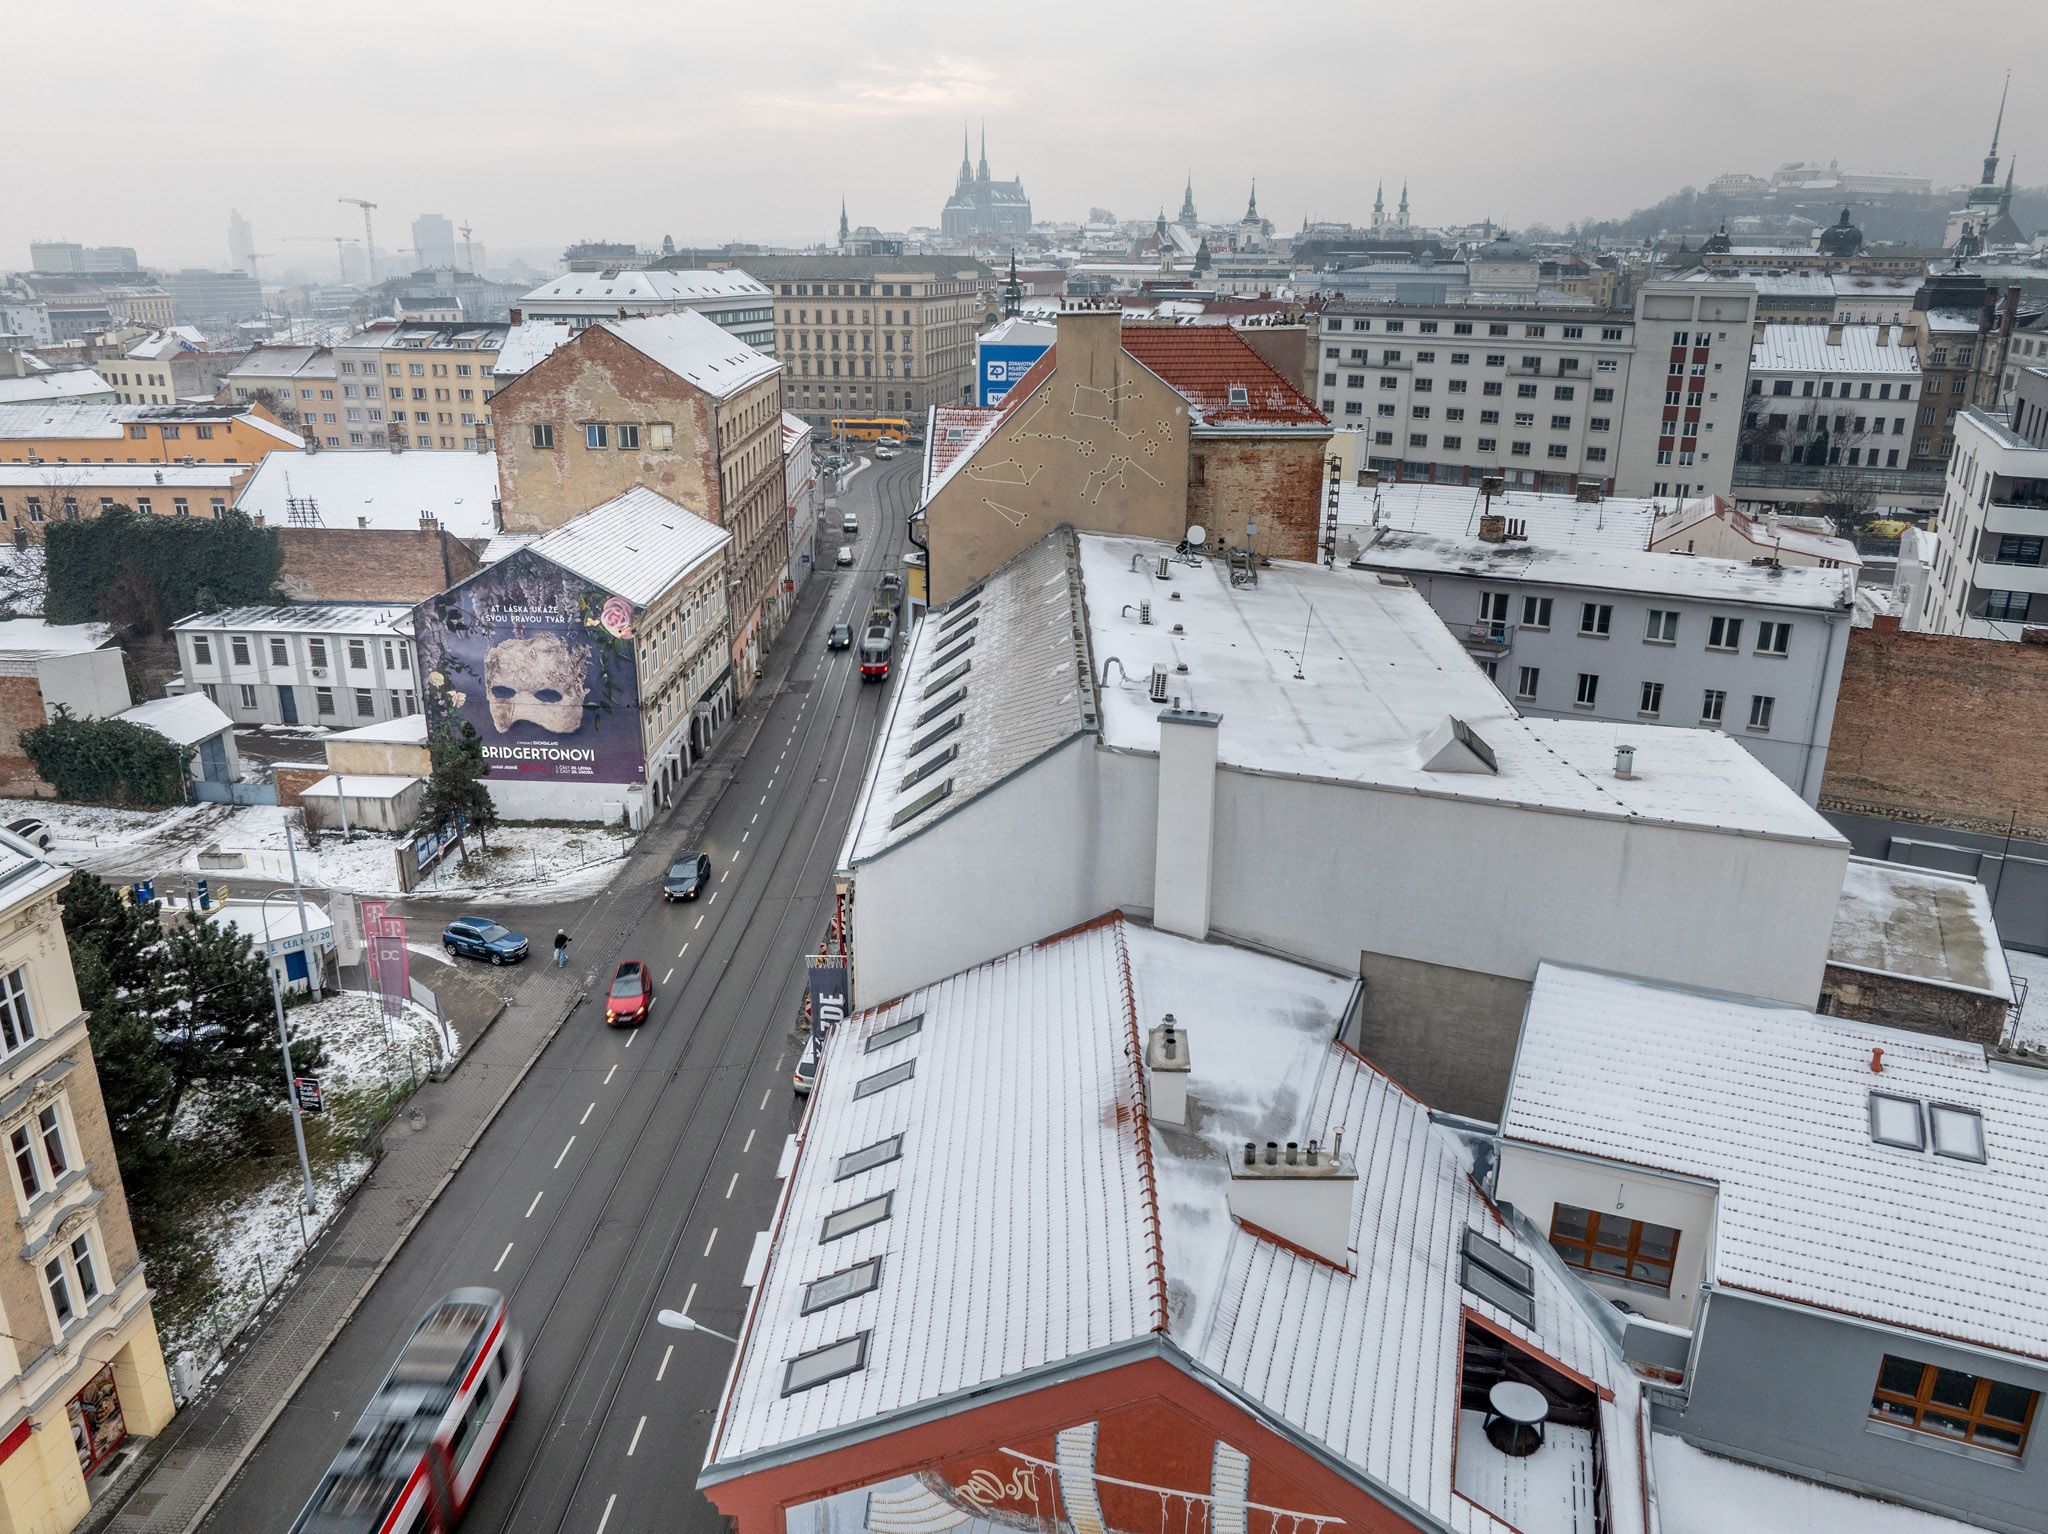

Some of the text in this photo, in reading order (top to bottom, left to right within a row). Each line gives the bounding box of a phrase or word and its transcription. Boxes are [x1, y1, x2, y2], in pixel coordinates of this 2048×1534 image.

[503, 604, 528, 613] LÁSKA
[532, 604, 558, 614] UKÁŽE
[485, 614, 565, 623] SVOU PRAVOU TVÁŘ
[481, 746, 595, 761] BRIDGERTONOVI
[283, 938, 299, 949] CEJL
